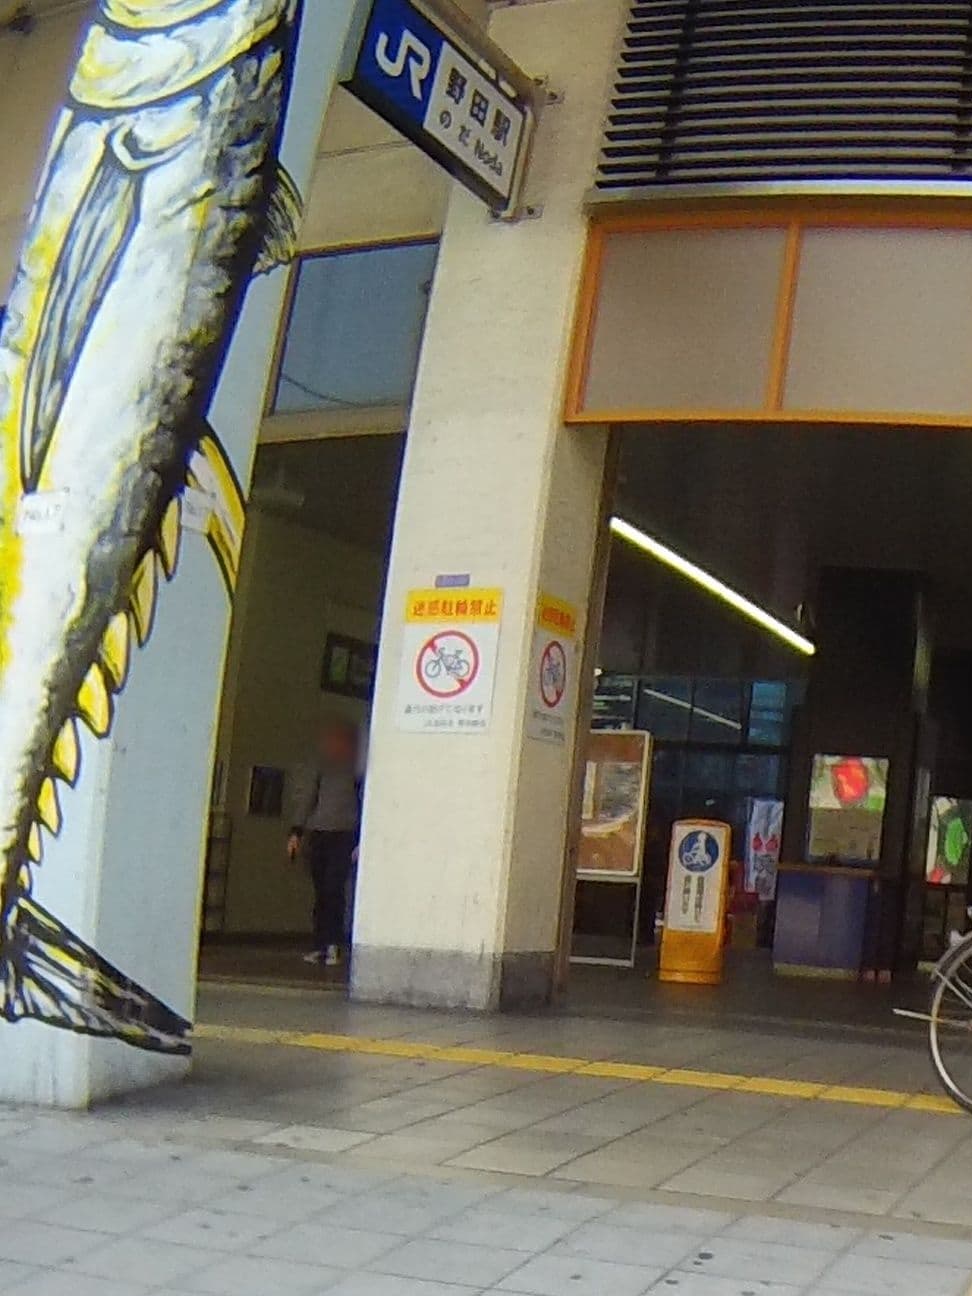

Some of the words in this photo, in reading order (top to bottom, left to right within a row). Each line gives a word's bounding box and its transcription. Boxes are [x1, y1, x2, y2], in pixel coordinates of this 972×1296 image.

[375, 28, 431, 101] JR
[447, 67, 511, 147] 野田駅
